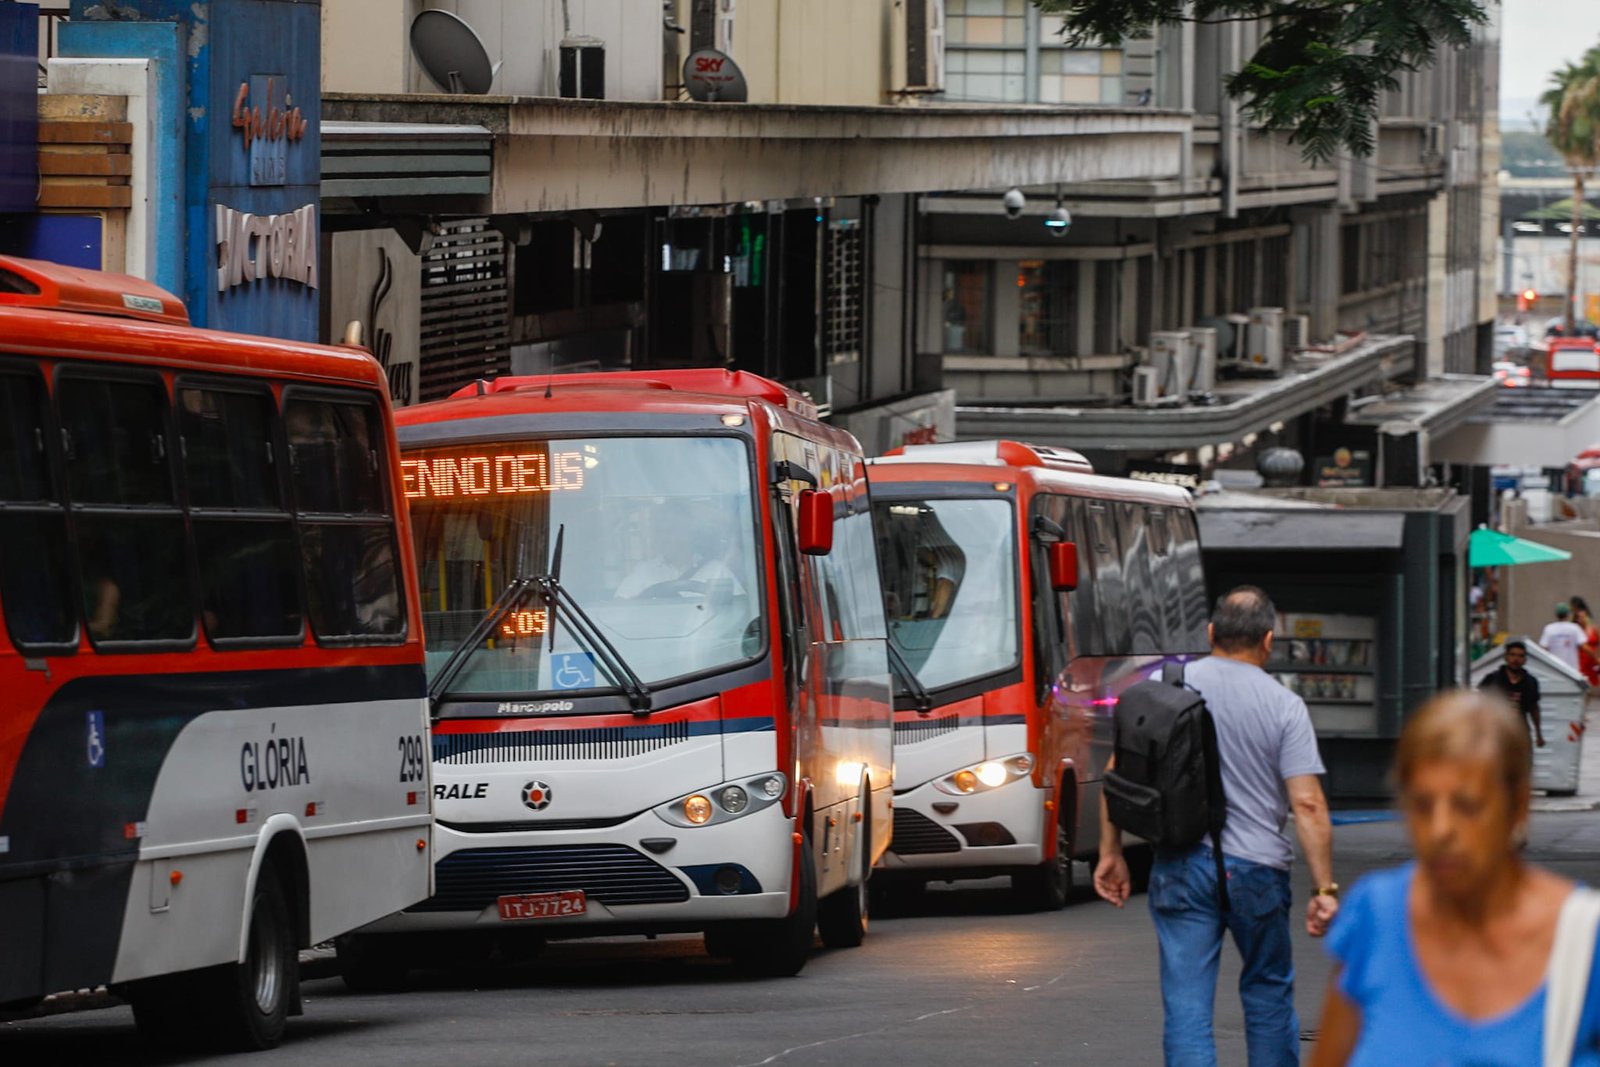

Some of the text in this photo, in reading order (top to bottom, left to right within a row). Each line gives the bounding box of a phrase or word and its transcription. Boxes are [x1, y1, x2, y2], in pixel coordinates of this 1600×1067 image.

[695, 56, 725, 72] SKY
[495, 452, 584, 494] DEUS
[497, 701, 574, 713] Marcopolo
[240, 722, 424, 792] GLÓRIA 299
